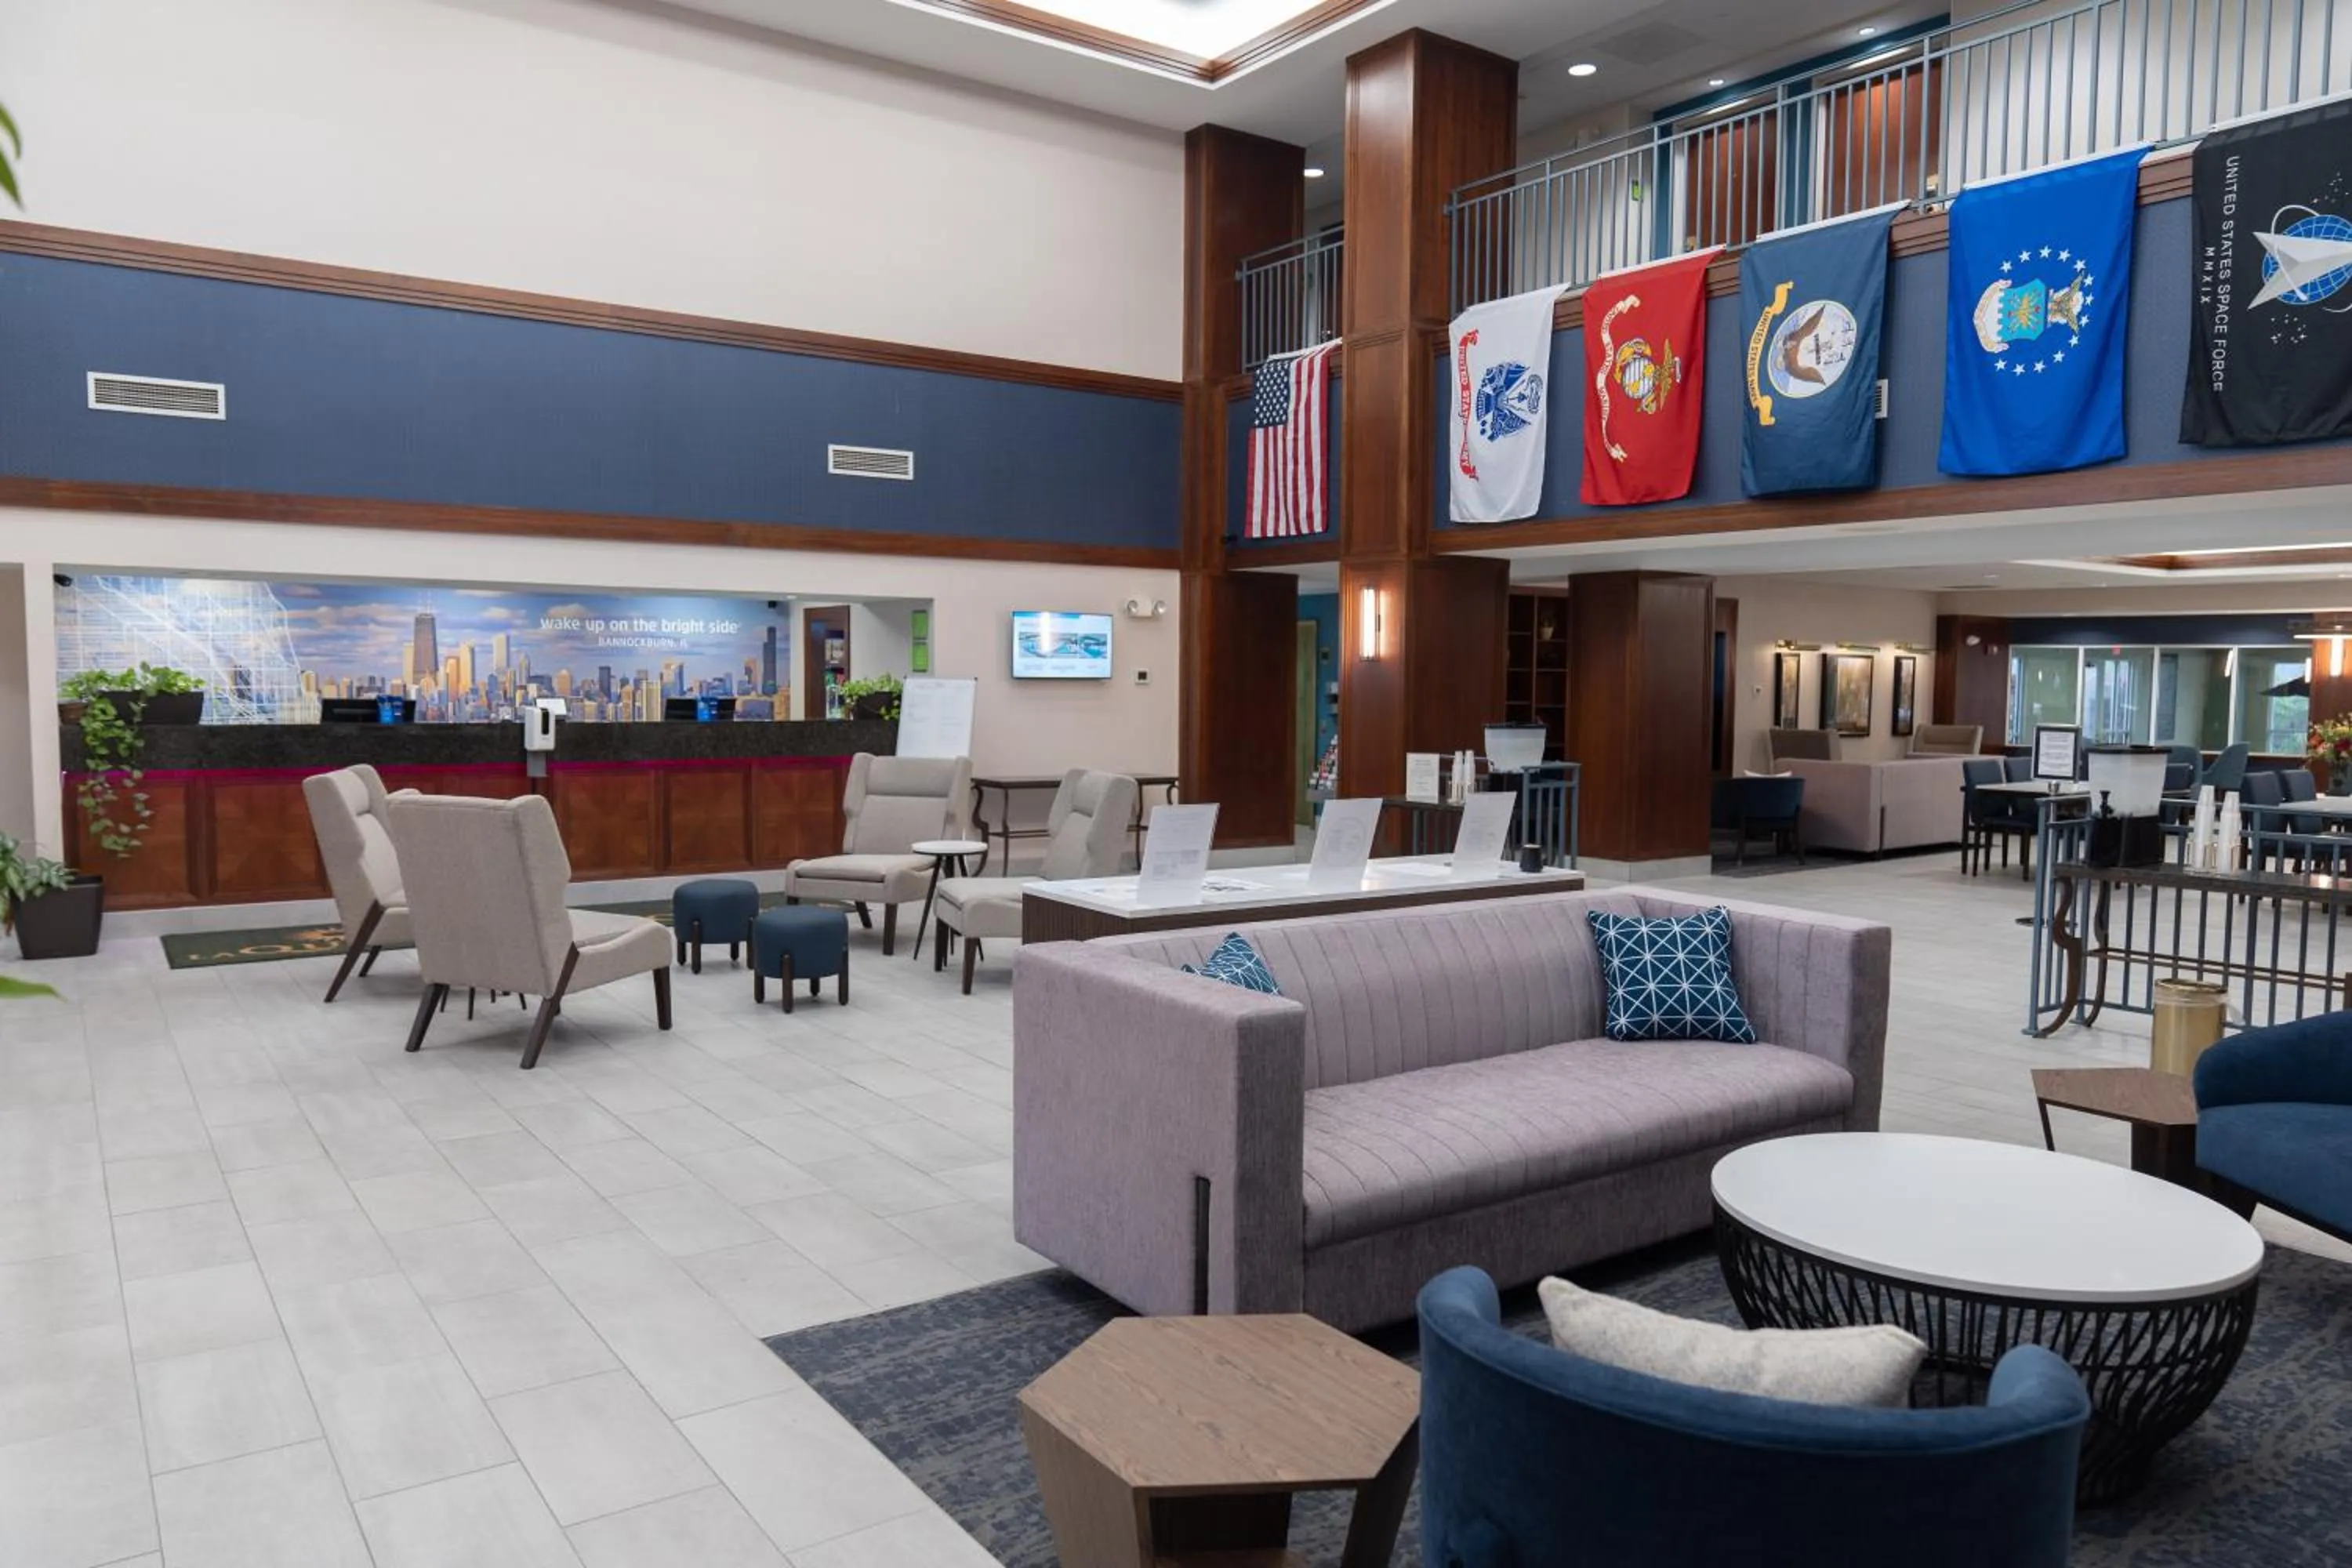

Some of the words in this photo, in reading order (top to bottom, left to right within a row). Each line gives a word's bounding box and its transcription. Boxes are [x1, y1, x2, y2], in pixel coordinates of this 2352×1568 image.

[2223, 156, 2241, 215] UNITED
[2200, 246, 2215, 304] MMXIX
[2219, 220, 2234, 280] STATES
[1751, 310, 1771, 345] UNITED
[2215, 285, 2230, 333] SPACE
[2212, 338, 2227, 393] FORCE
[539, 615, 580, 630] wake
[585, 618, 604, 634] up
[609, 619, 627, 631] on
[633, 618, 656, 632] the
[661, 618, 704, 635] bright
[707, 619, 739, 634] side
